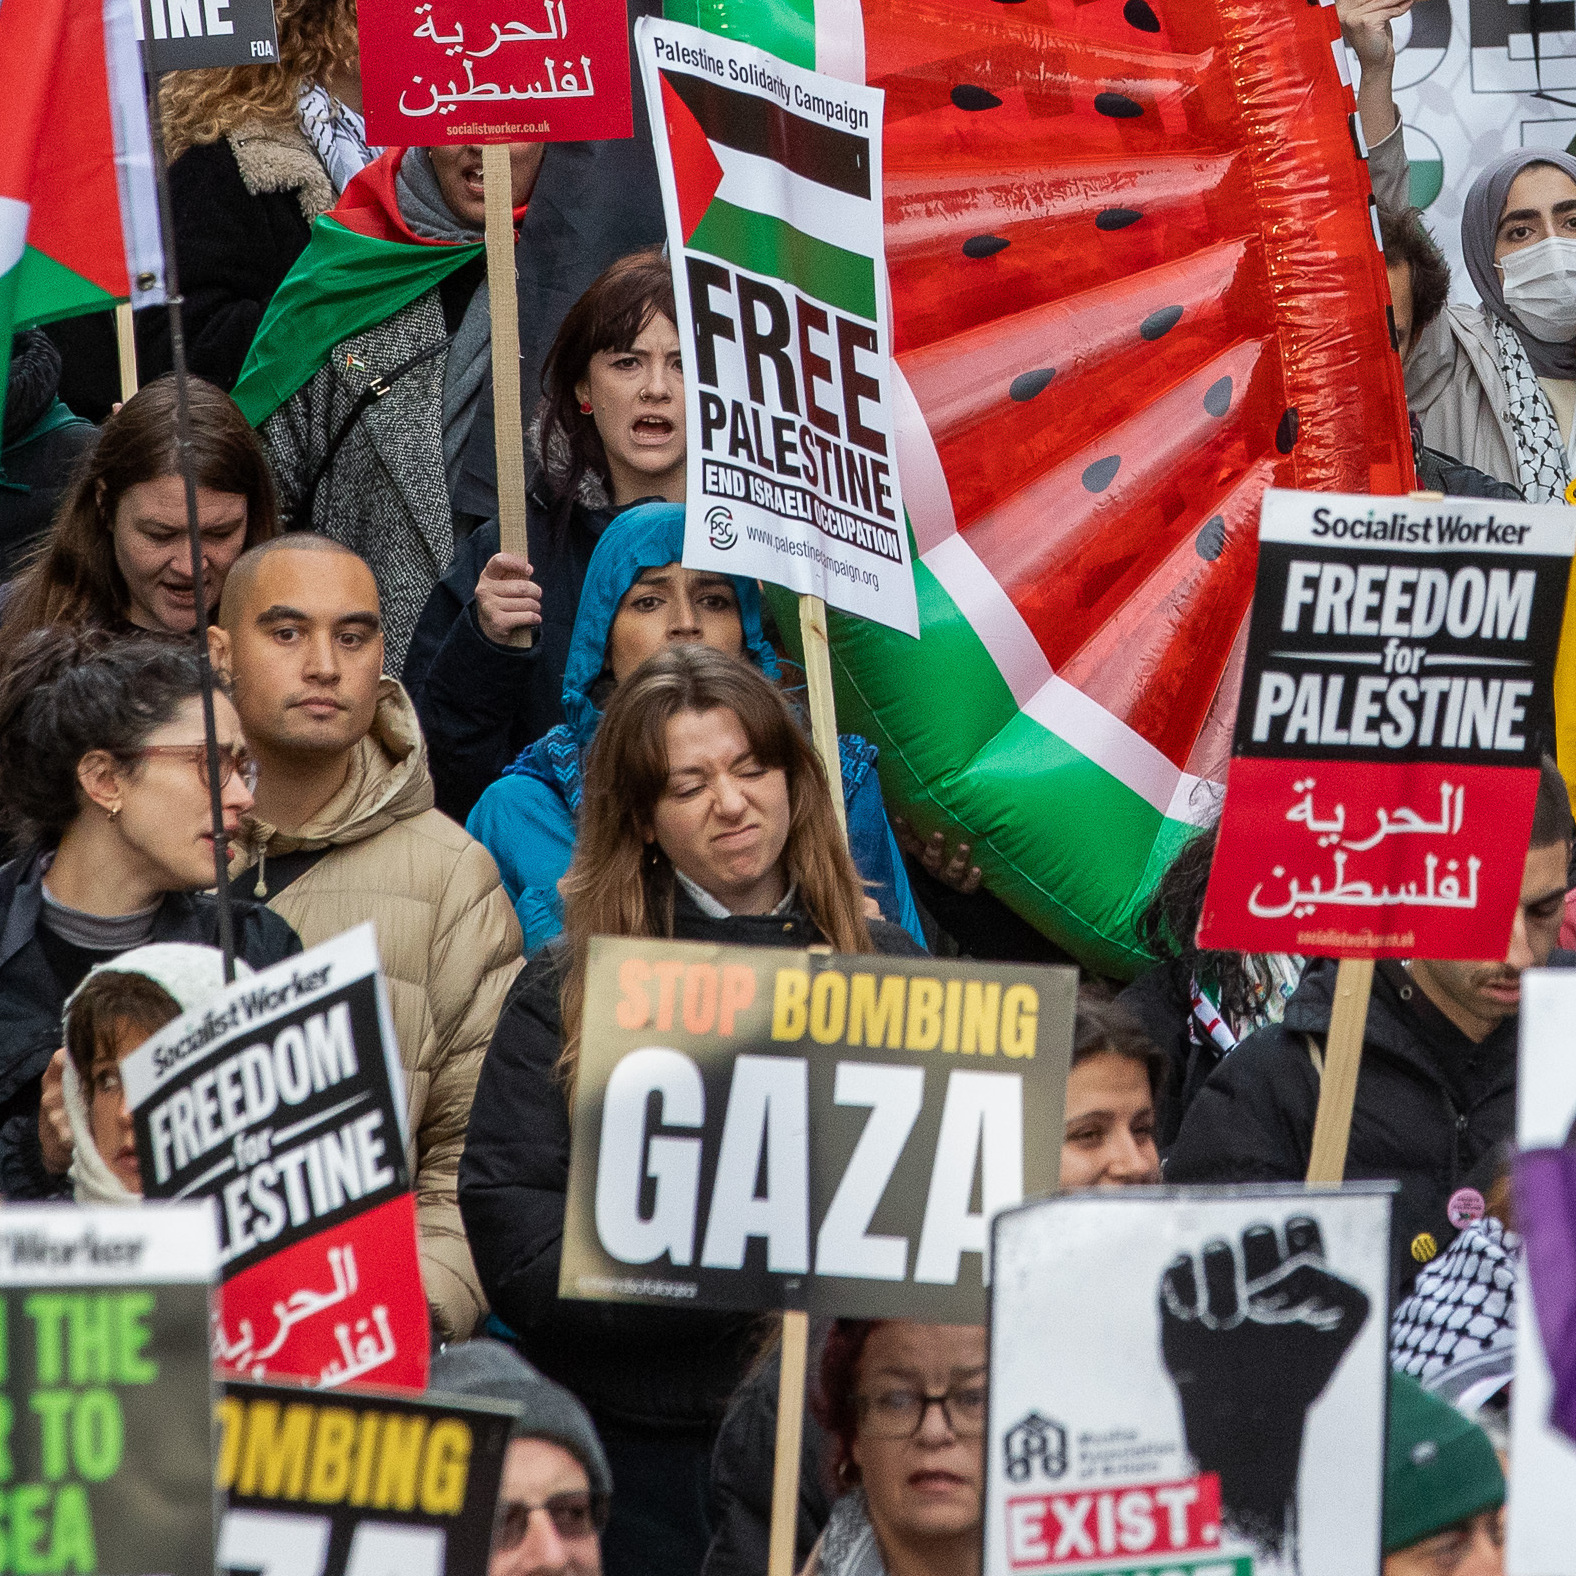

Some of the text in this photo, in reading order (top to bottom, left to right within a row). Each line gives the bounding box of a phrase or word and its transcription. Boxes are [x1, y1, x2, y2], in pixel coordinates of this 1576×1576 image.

[250, 39, 274, 58] FOA
[398, 54, 595, 117] لفلسطين
[654, 35, 870, 129] Palestine Solidarity Campaign
[446, 121, 550, 136] socialistworker.co.uk
[685, 255, 889, 458] FREE
[699, 388, 897, 523] PALESTINE
[706, 465, 902, 563] END ISRAELI OCCUPATION
[709, 517, 733, 538] PSC
[1281, 560, 1537, 641] FREEDOM
[1382, 637, 1427, 675] for
[1251, 670, 1533, 752] PALESTINE
[1286, 776, 1464, 851] الحرية
[1247, 852, 1482, 919] لفلسطين
[616, 958, 1040, 1059] STOP BOMBING
[148, 1000, 360, 1186] FREEDOM
[217, 1108, 396, 1264] LESTINE
[232, 1123, 274, 1171] for
[596, 1046, 1025, 1288] GAZA
[25, 1292, 158, 1385] THE
[31, 1389, 124, 1483] TO
[1010, 1487, 1220, 1561] EXIST.
